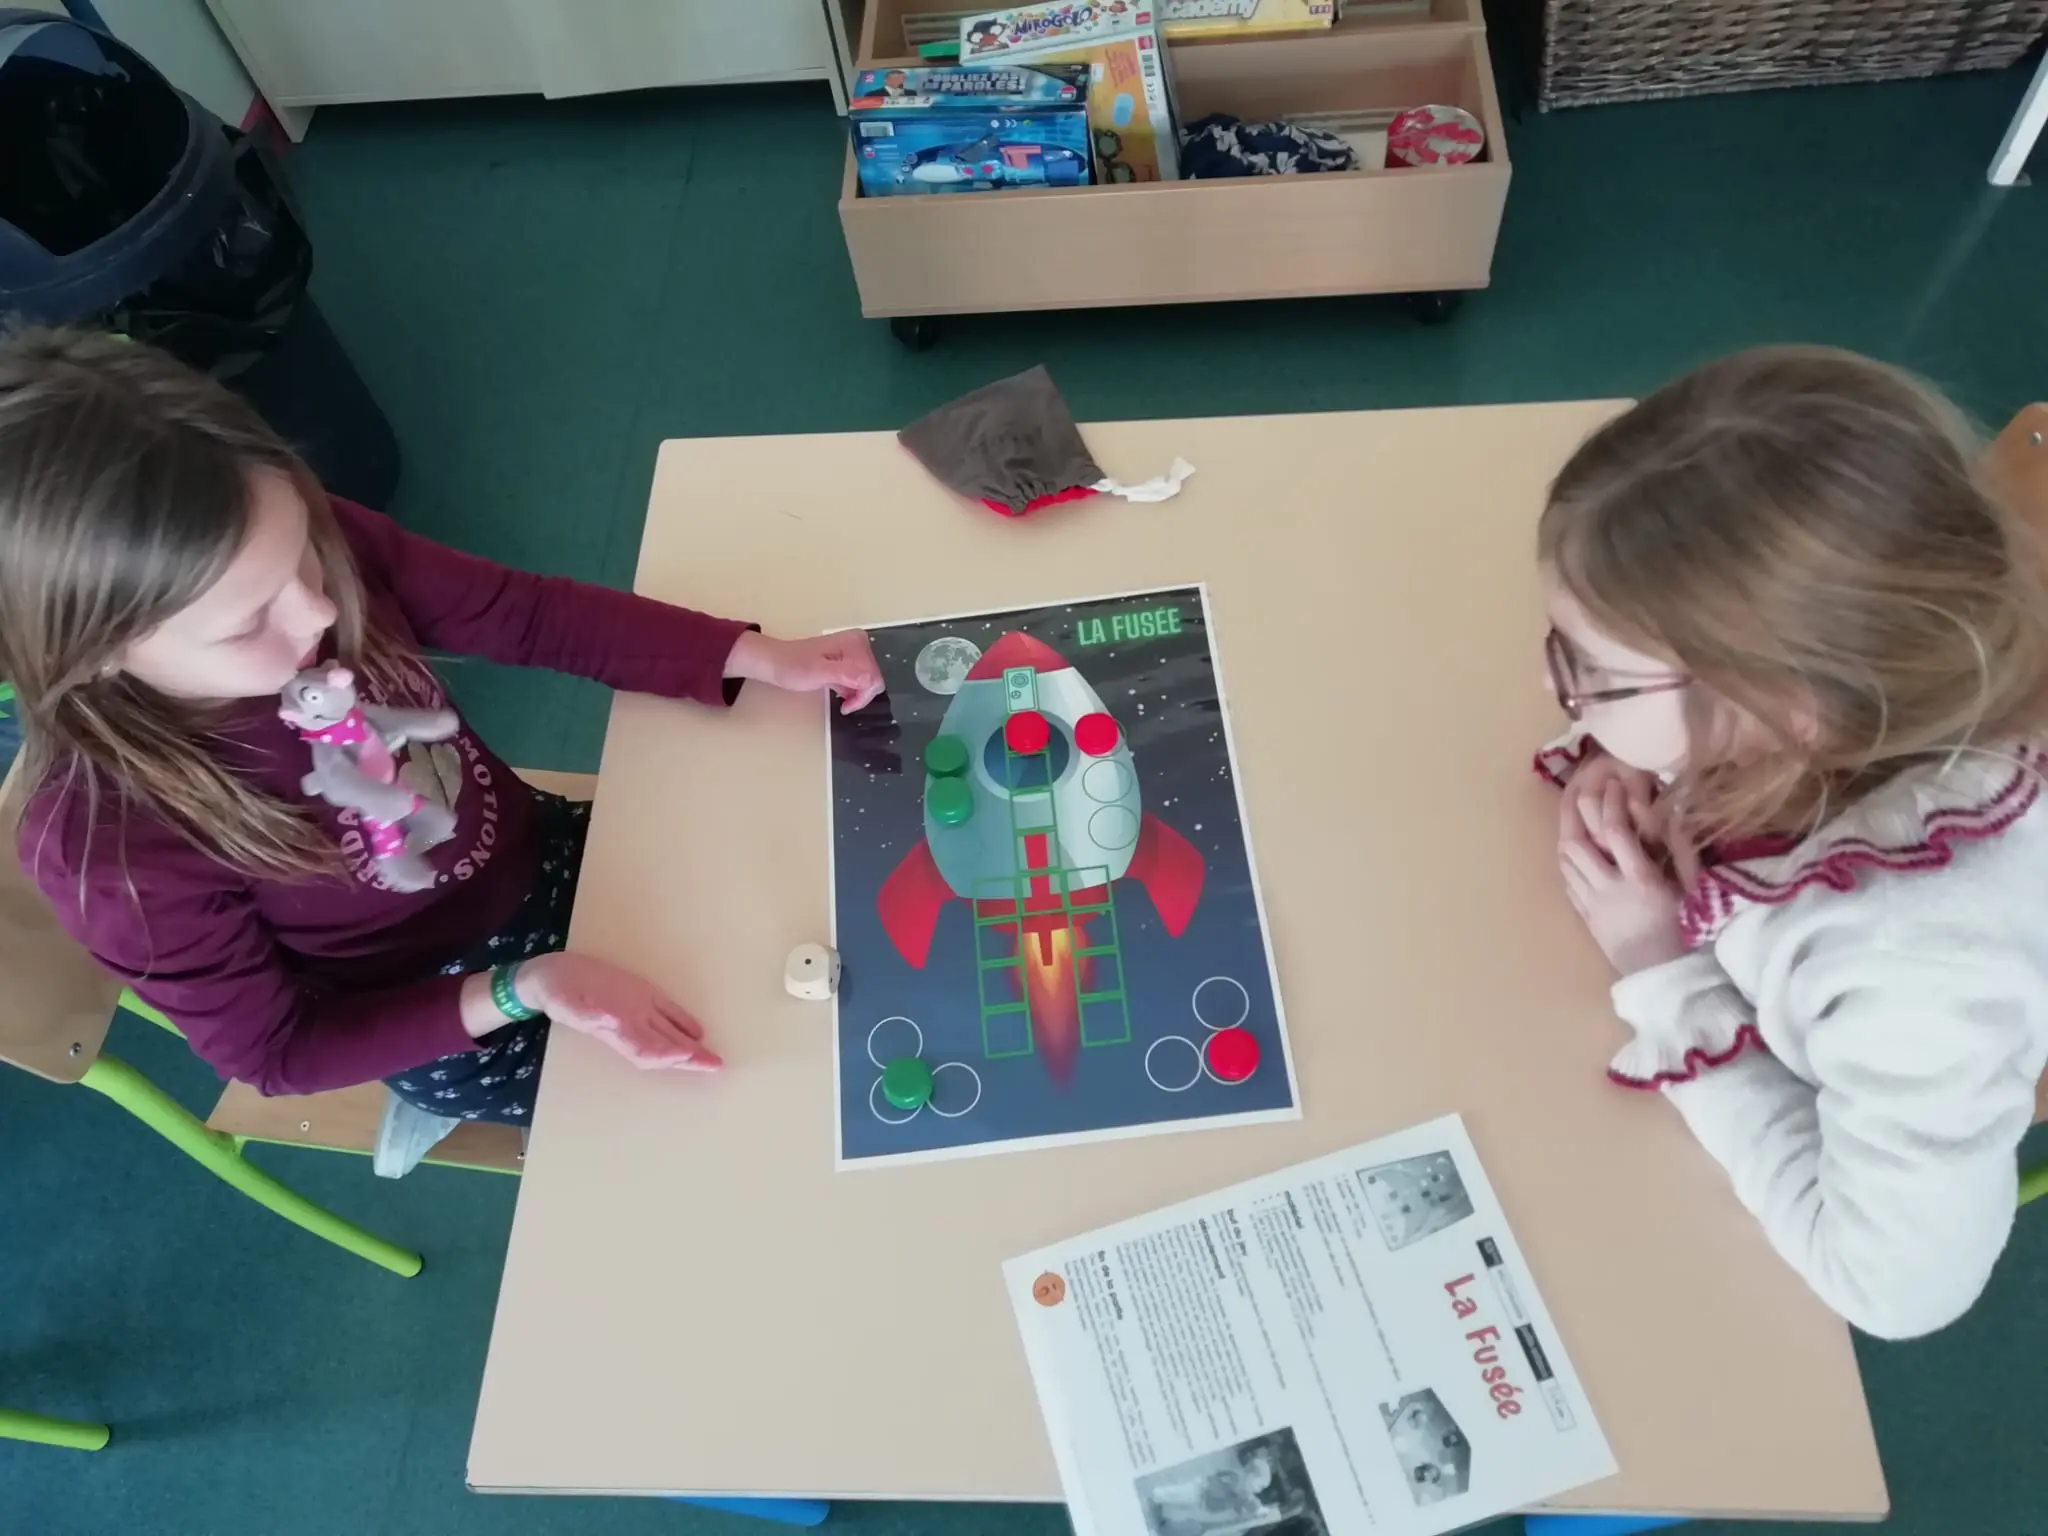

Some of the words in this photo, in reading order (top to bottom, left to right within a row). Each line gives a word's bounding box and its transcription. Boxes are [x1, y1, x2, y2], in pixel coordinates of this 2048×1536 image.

[1077, 618, 1107, 646] LA
[1111, 606, 1182, 641] FUSÉE
[453, 734, 499, 881] MOTIONS
[1444, 1273, 1478, 1319] La
[1465, 1325, 1524, 1419] Fusée
